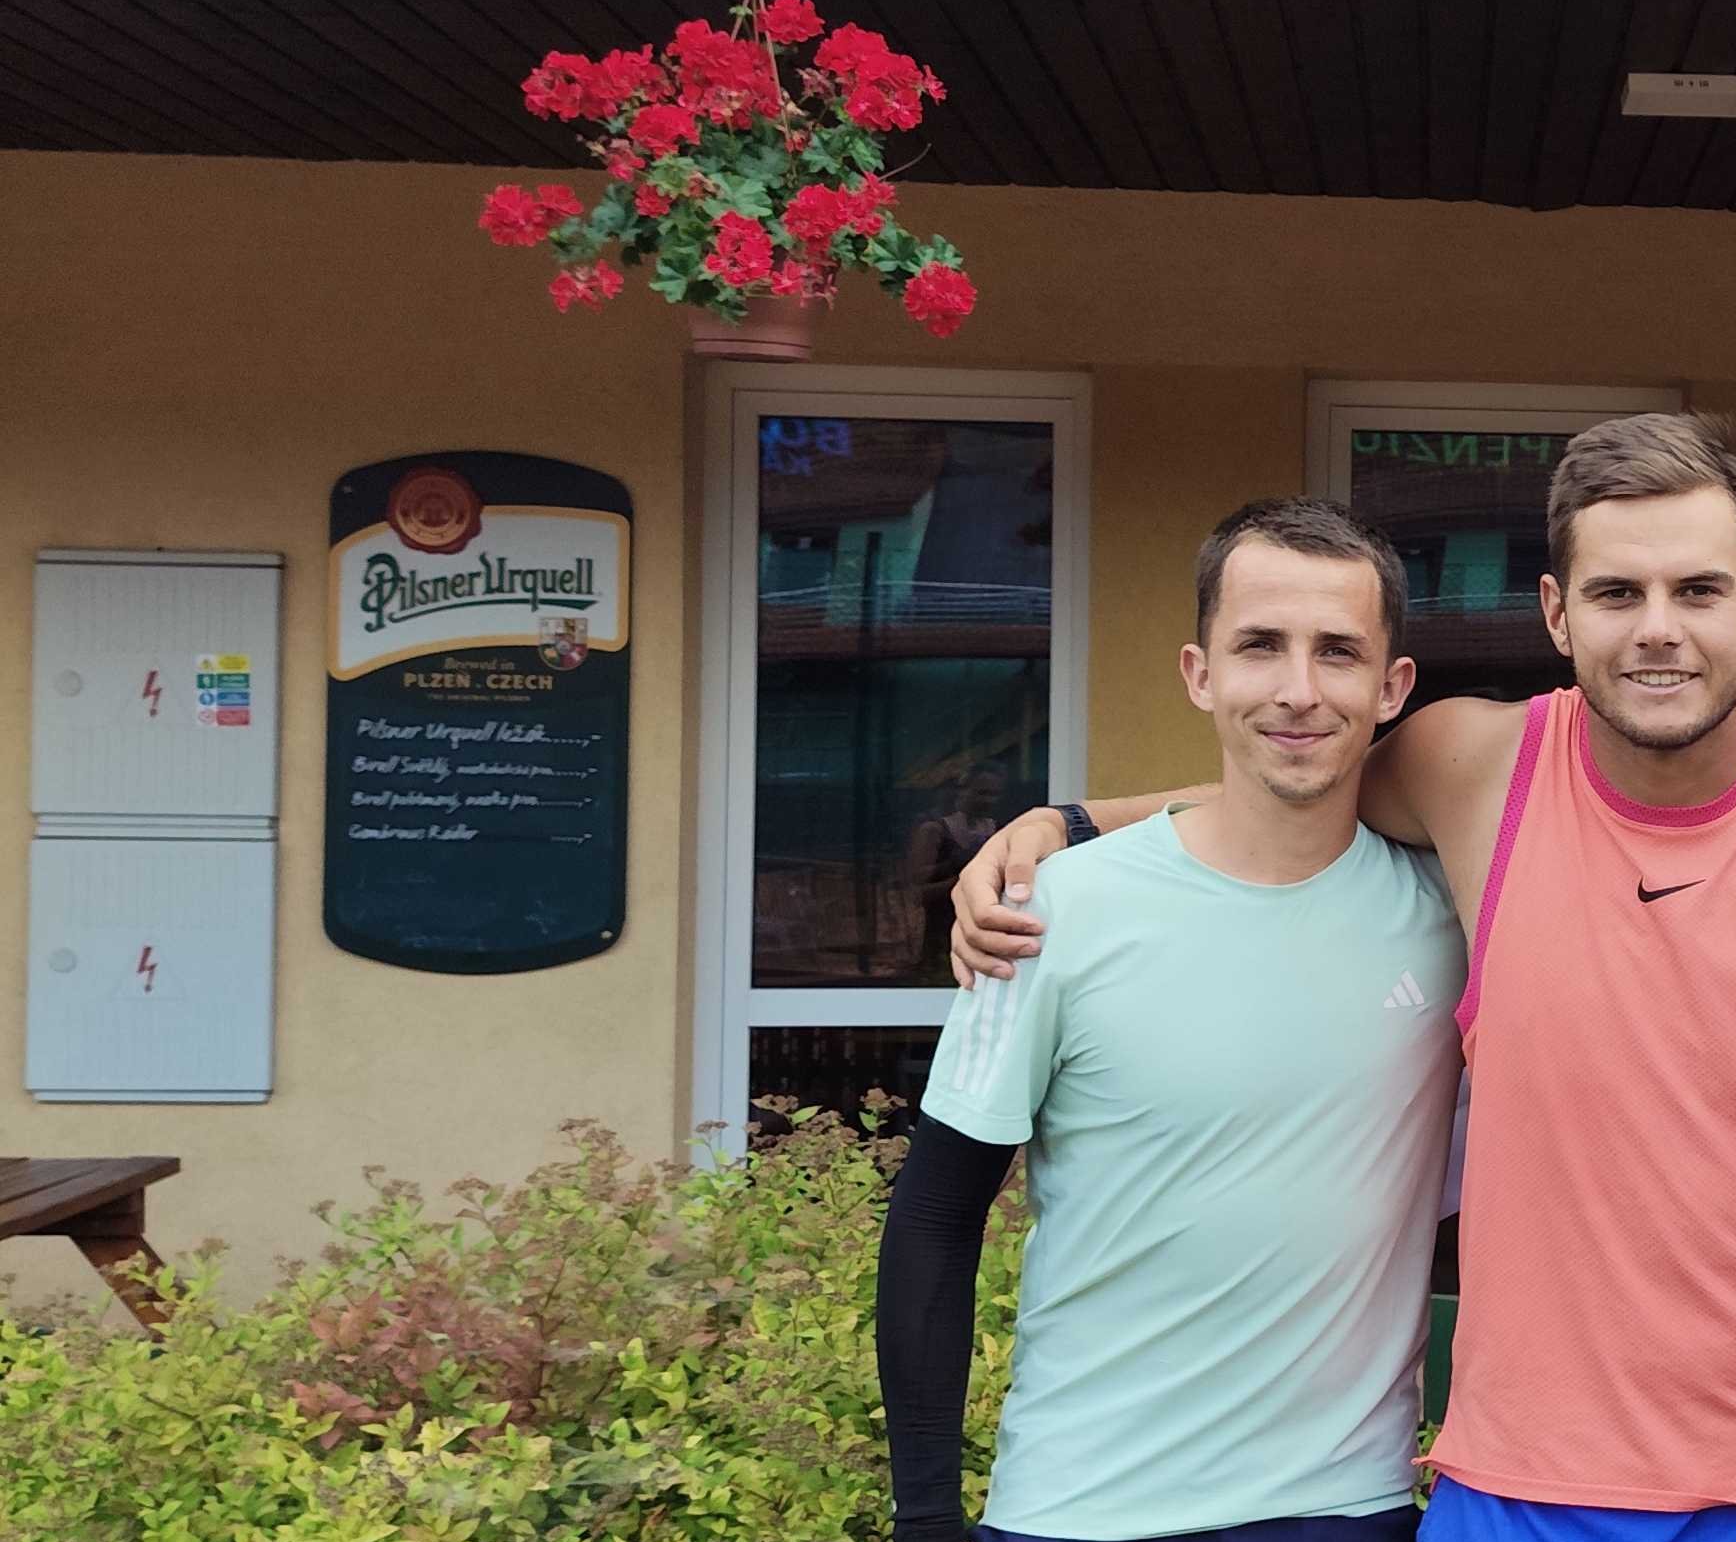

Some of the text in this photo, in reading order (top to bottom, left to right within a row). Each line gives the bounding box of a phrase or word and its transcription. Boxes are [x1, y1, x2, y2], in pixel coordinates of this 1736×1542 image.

[360, 552, 595, 633] Pilsner Urquell
[486, 673, 553, 690] CZECH
